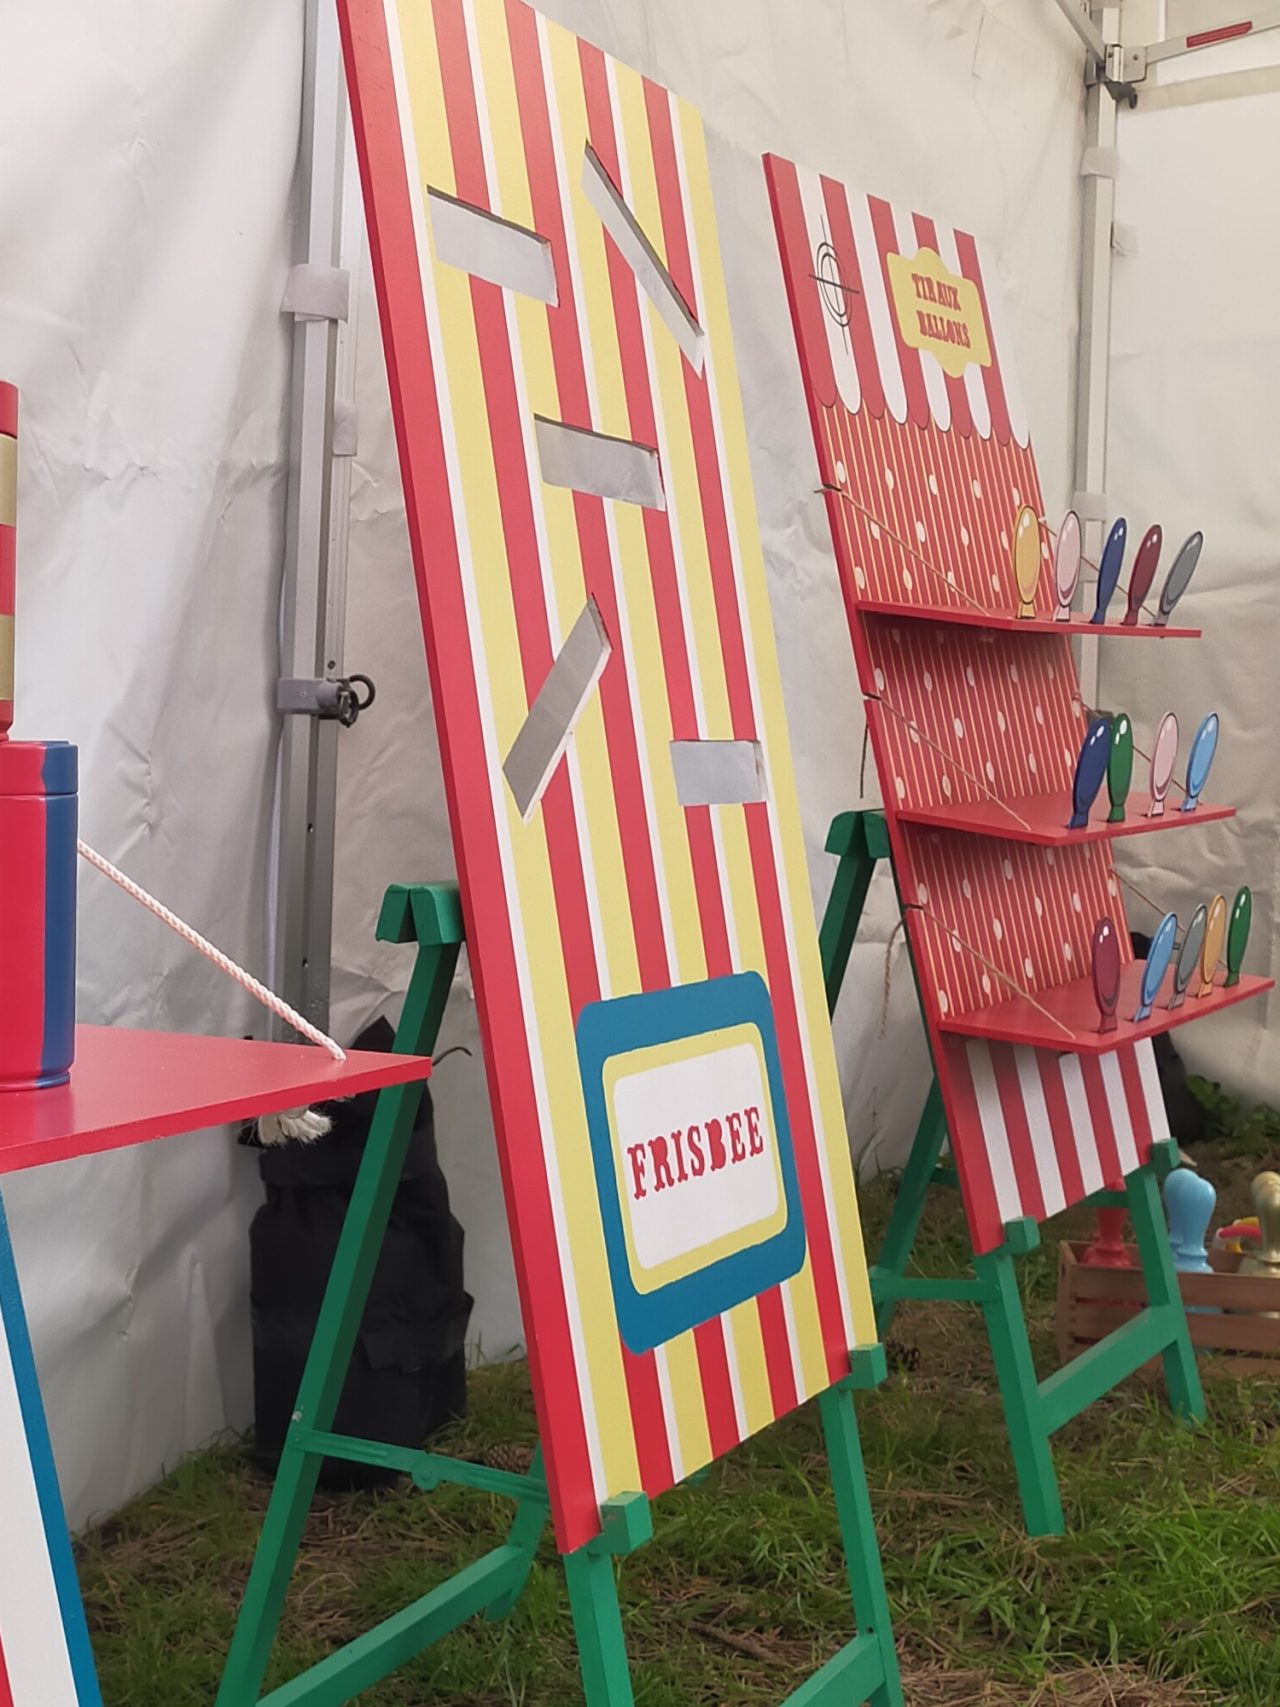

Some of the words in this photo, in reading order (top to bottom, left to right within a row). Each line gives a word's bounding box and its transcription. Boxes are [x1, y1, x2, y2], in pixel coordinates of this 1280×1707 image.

[911, 273, 937, 303] TIR
[936, 280, 962, 311] AUX
[916, 310, 971, 349] BALLONS
[627, 1106, 764, 1200] FRISBEE
